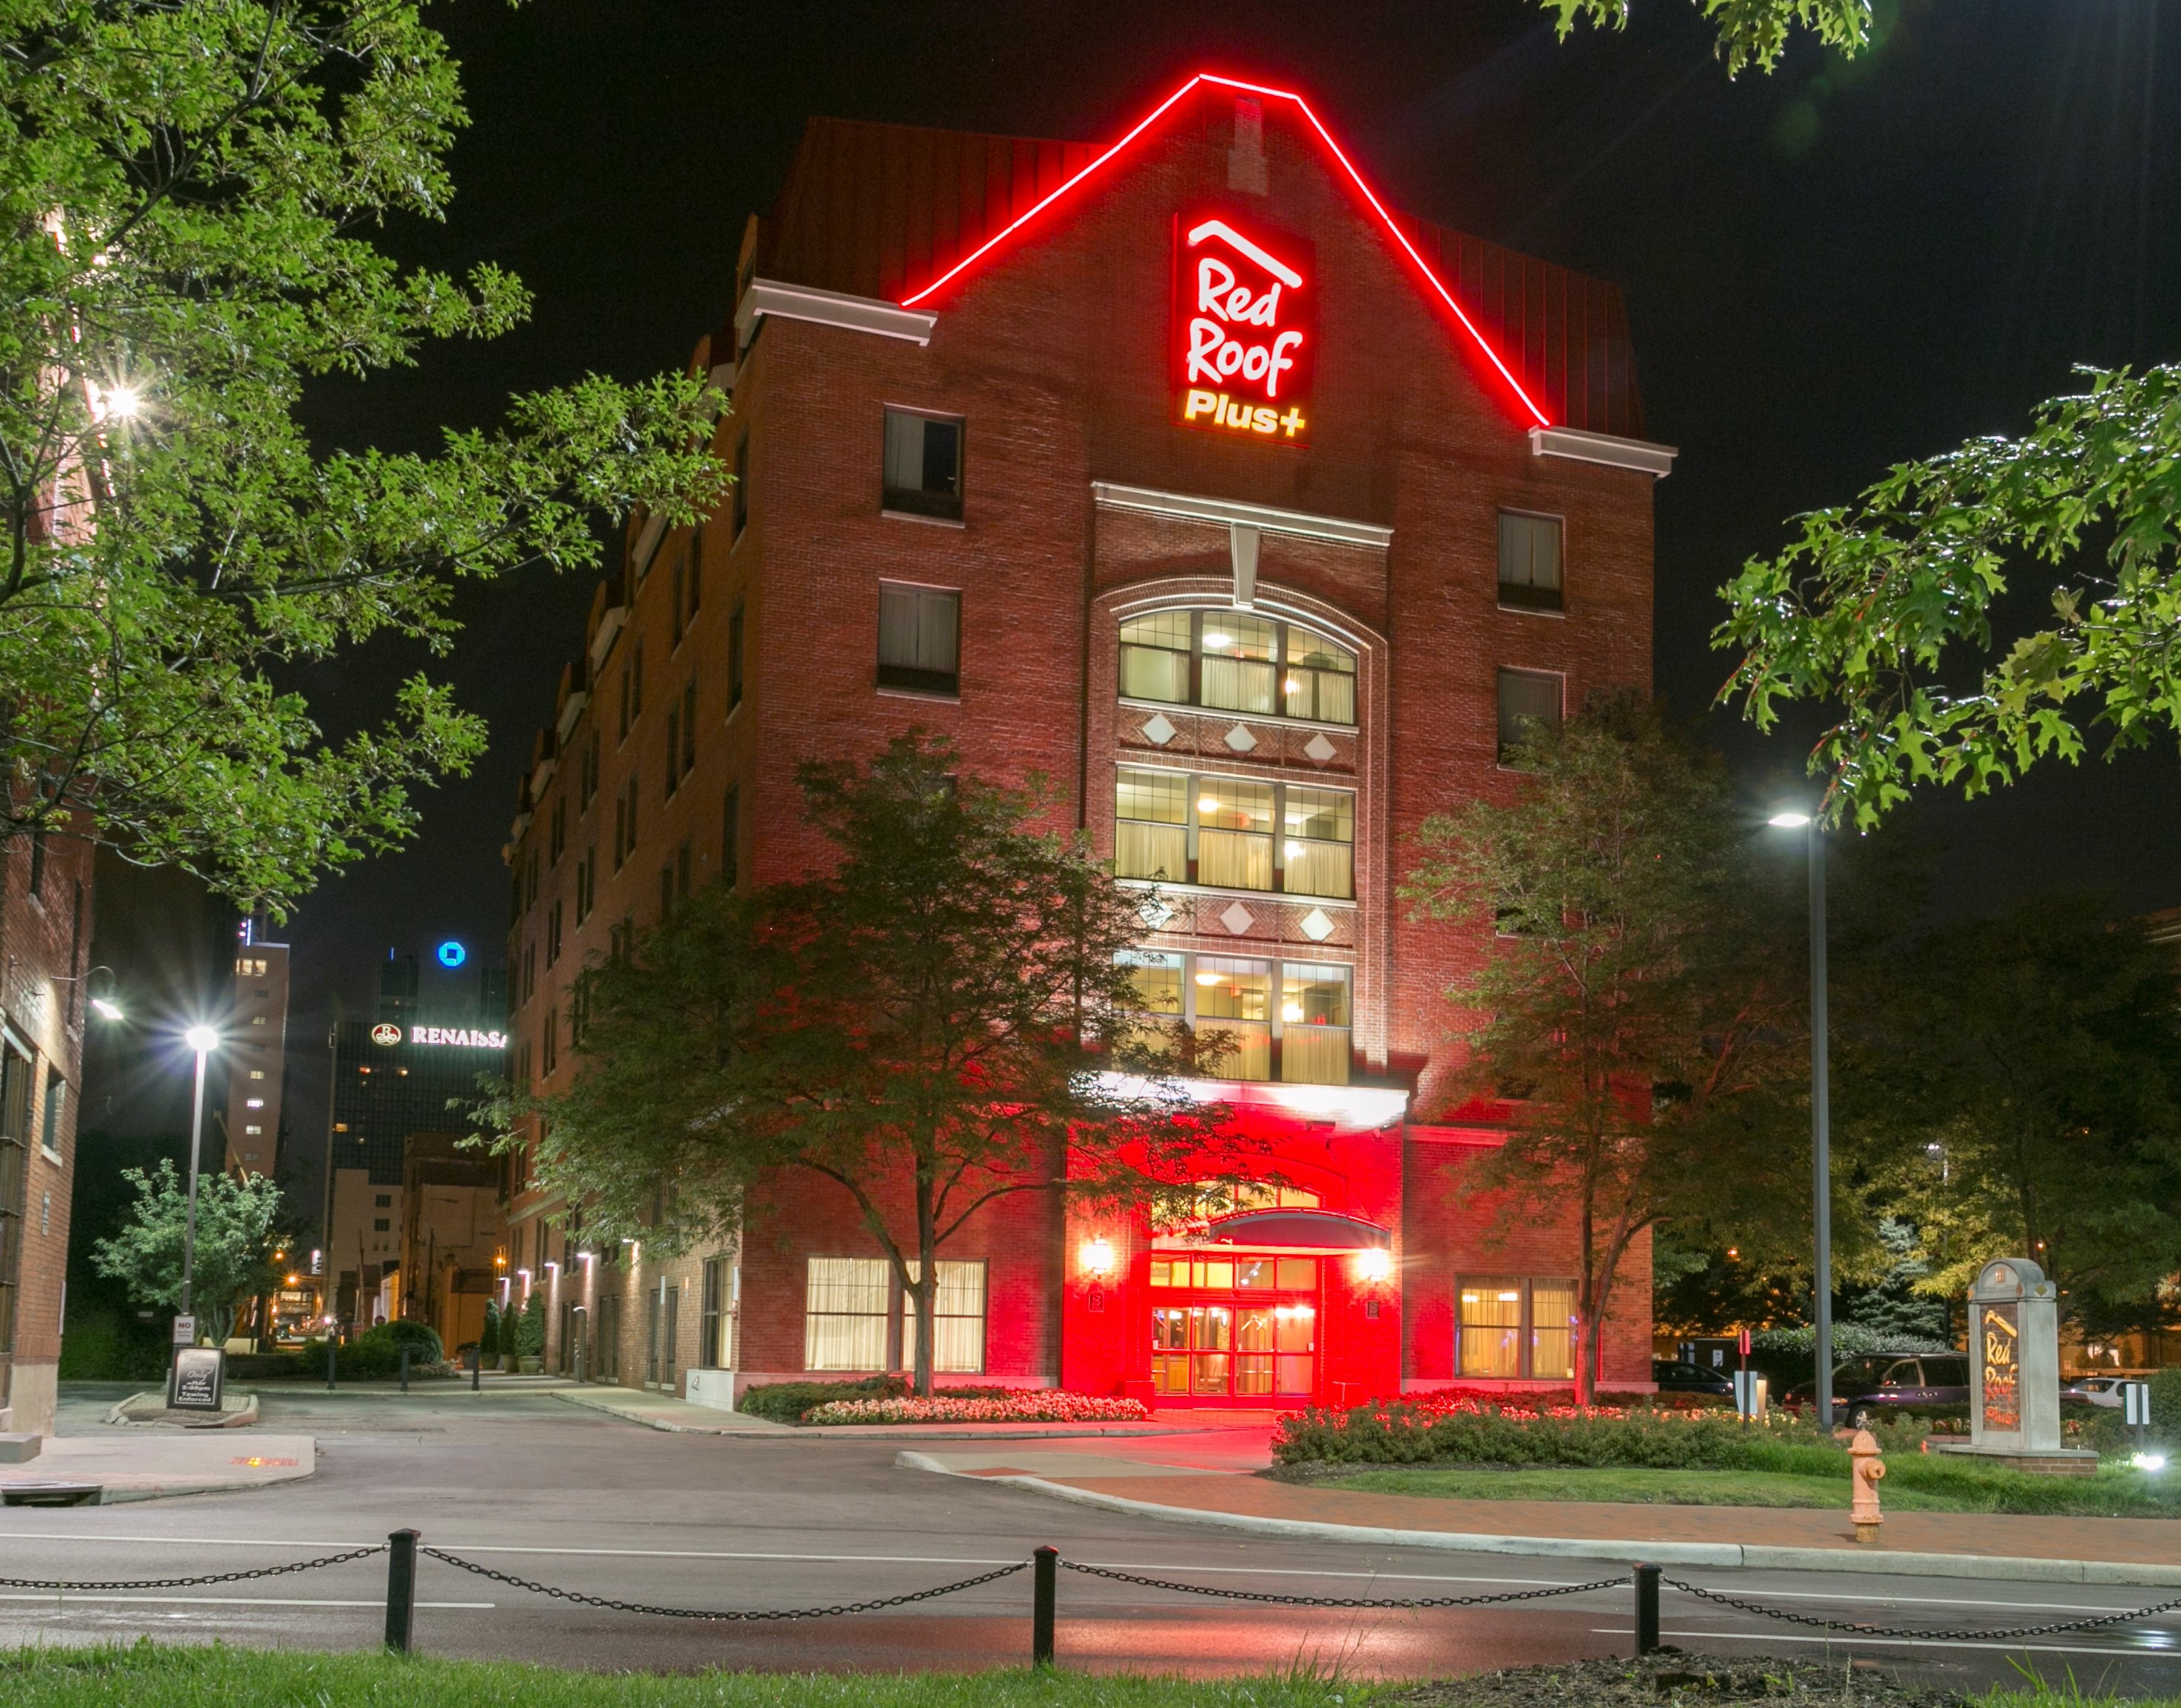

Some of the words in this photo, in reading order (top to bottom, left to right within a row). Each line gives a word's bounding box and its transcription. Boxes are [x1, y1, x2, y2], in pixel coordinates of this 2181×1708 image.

[1198, 257, 1282, 327] Red
[1187, 317, 1303, 397] Roof
[1184, 389, 1306, 437] Plus+
[1986, 1331, 2012, 1366] Red
[187, 1370, 207, 1383] Only
[1985, 1364, 2018, 1403] Roof
